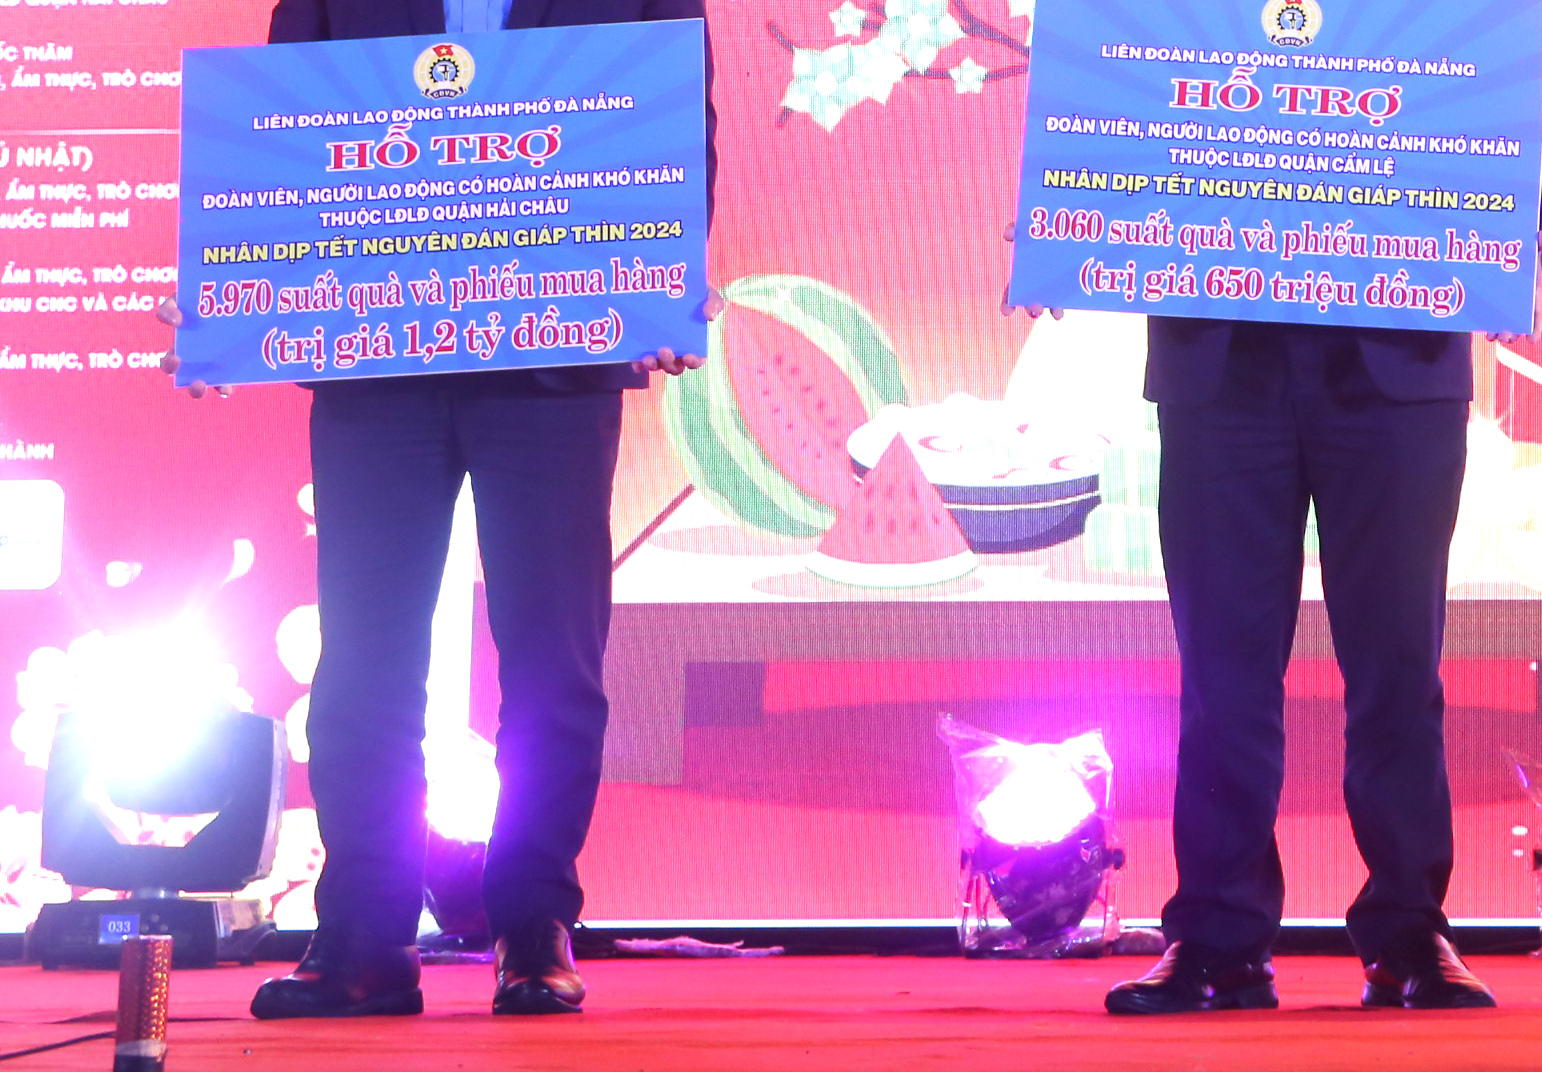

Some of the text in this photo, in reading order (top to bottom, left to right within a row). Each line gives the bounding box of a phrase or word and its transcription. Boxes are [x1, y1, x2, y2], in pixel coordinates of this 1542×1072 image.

[253, 93, 634, 130] LIÊN ĐOÀN LAO ĐỘNG THÀNH PHỐ ĐÀ NẴNG
[326, 121, 562, 172] HỖ TRỢ
[1169, 147, 1395, 178] THUỘC LĐLĐ QUẬN CẨM LỆ
[203, 165, 684, 209] ĐOÀN VIÊN, NGƯỜI LAO ĐỘNG CÓ HOÀN CẢNH KHÓ KHĂN
[320, 197, 569, 231] THUỘC LĐLĐ QUẬN HẢI CHÂU
[203, 221, 683, 265] NHÂN DỊP TẾT NGUYÊN ĐÁN GIÁP THÌN 2024
[1030, 207, 1521, 271] 3.060 suất quà và phiếu mua hàng
[199, 258, 686, 318] 5.970 suất quà và phiếu mua hàng
[1080, 257, 1464, 316] (trị giá 650 triệu đồng)
[261, 306, 624, 372] (trị giá 1,2 tỷ đồng)
[108, 920, 131, 933] 033
